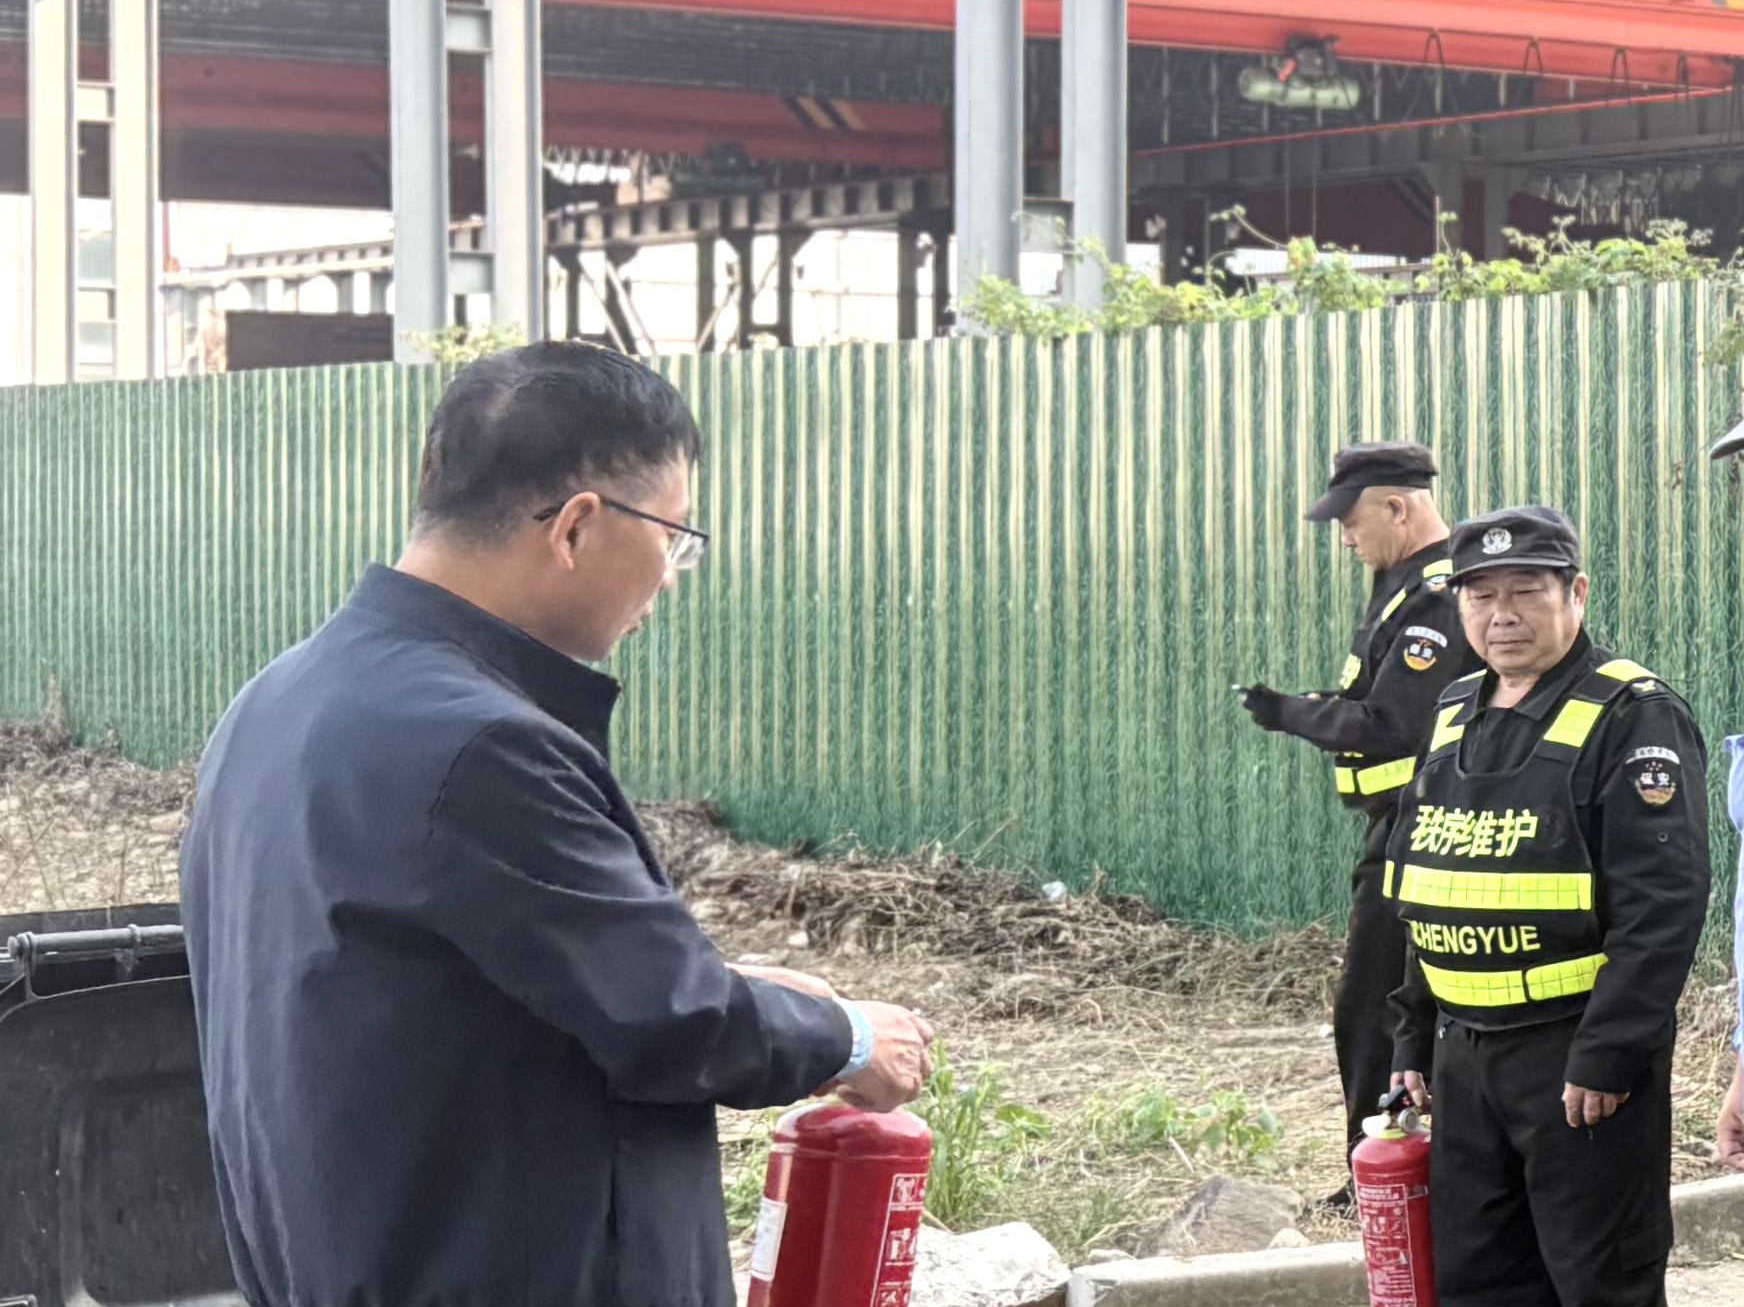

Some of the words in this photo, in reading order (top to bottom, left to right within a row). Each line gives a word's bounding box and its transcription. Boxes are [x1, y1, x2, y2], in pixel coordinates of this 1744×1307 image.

[1410, 805, 1539, 858] 秩序维护
[1411, 920, 1542, 956] CHENGYUE
